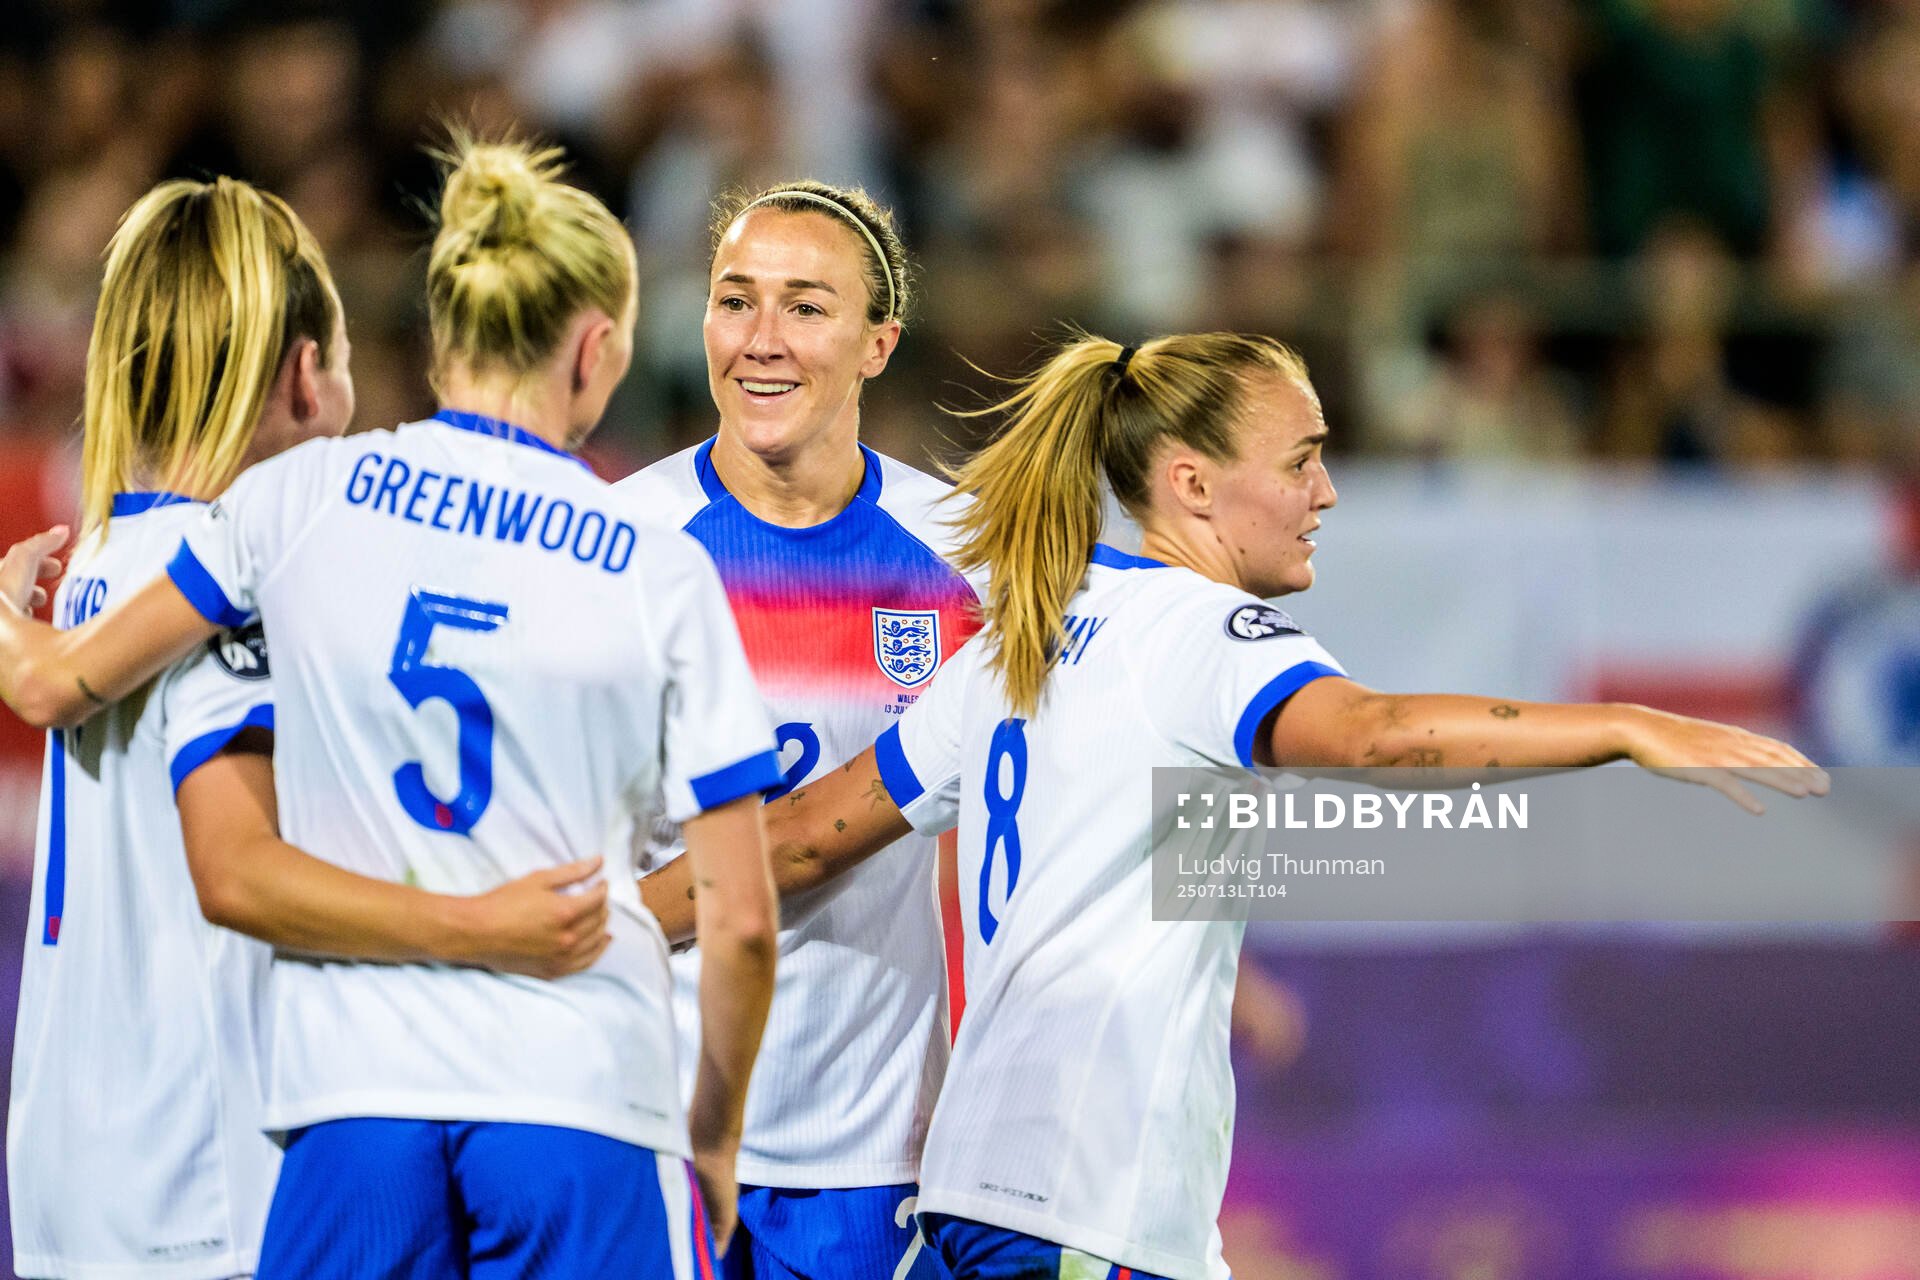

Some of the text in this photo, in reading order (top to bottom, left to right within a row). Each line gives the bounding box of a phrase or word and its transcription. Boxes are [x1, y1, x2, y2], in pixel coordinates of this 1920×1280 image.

[346, 452, 636, 573] GREENWOOD
[388, 588, 508, 836] 5
[764, 722, 820, 804] 2
[884, 704, 892, 713] 13
[979, 718, 1028, 946] 8
